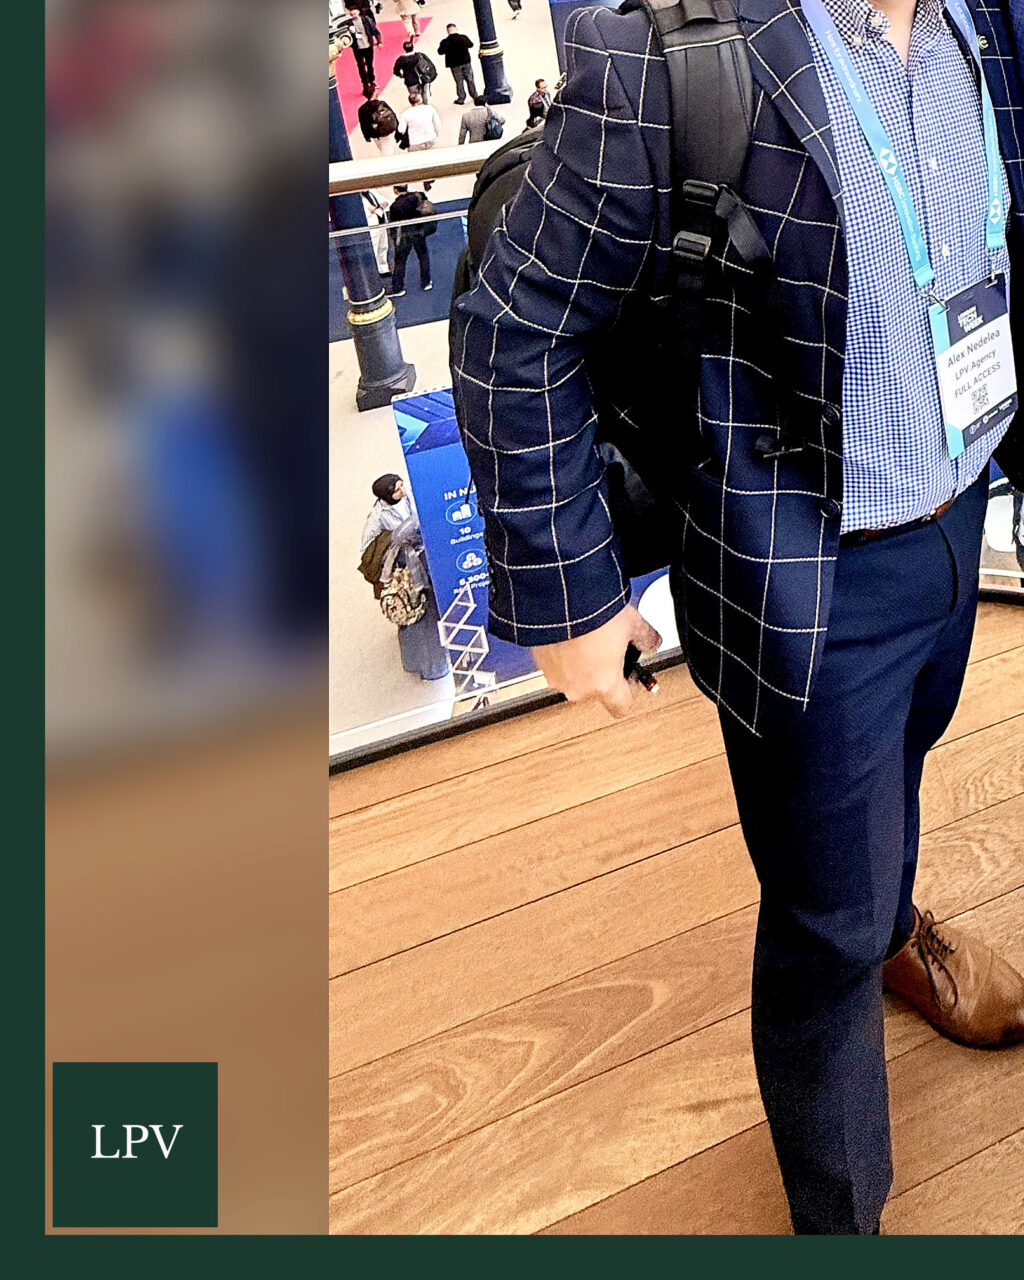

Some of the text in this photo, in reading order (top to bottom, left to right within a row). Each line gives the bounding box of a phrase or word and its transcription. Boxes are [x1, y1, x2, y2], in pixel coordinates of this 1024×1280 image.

[948, 329, 1000, 368] Alex Nedelea
[955, 349, 996, 380] LPV Agency
[955, 361, 1001, 398] FULL ACCESS
[444, 489, 457, 500] IN
[450, 532, 484, 545] Buildings
[459, 526, 471, 535] 10
